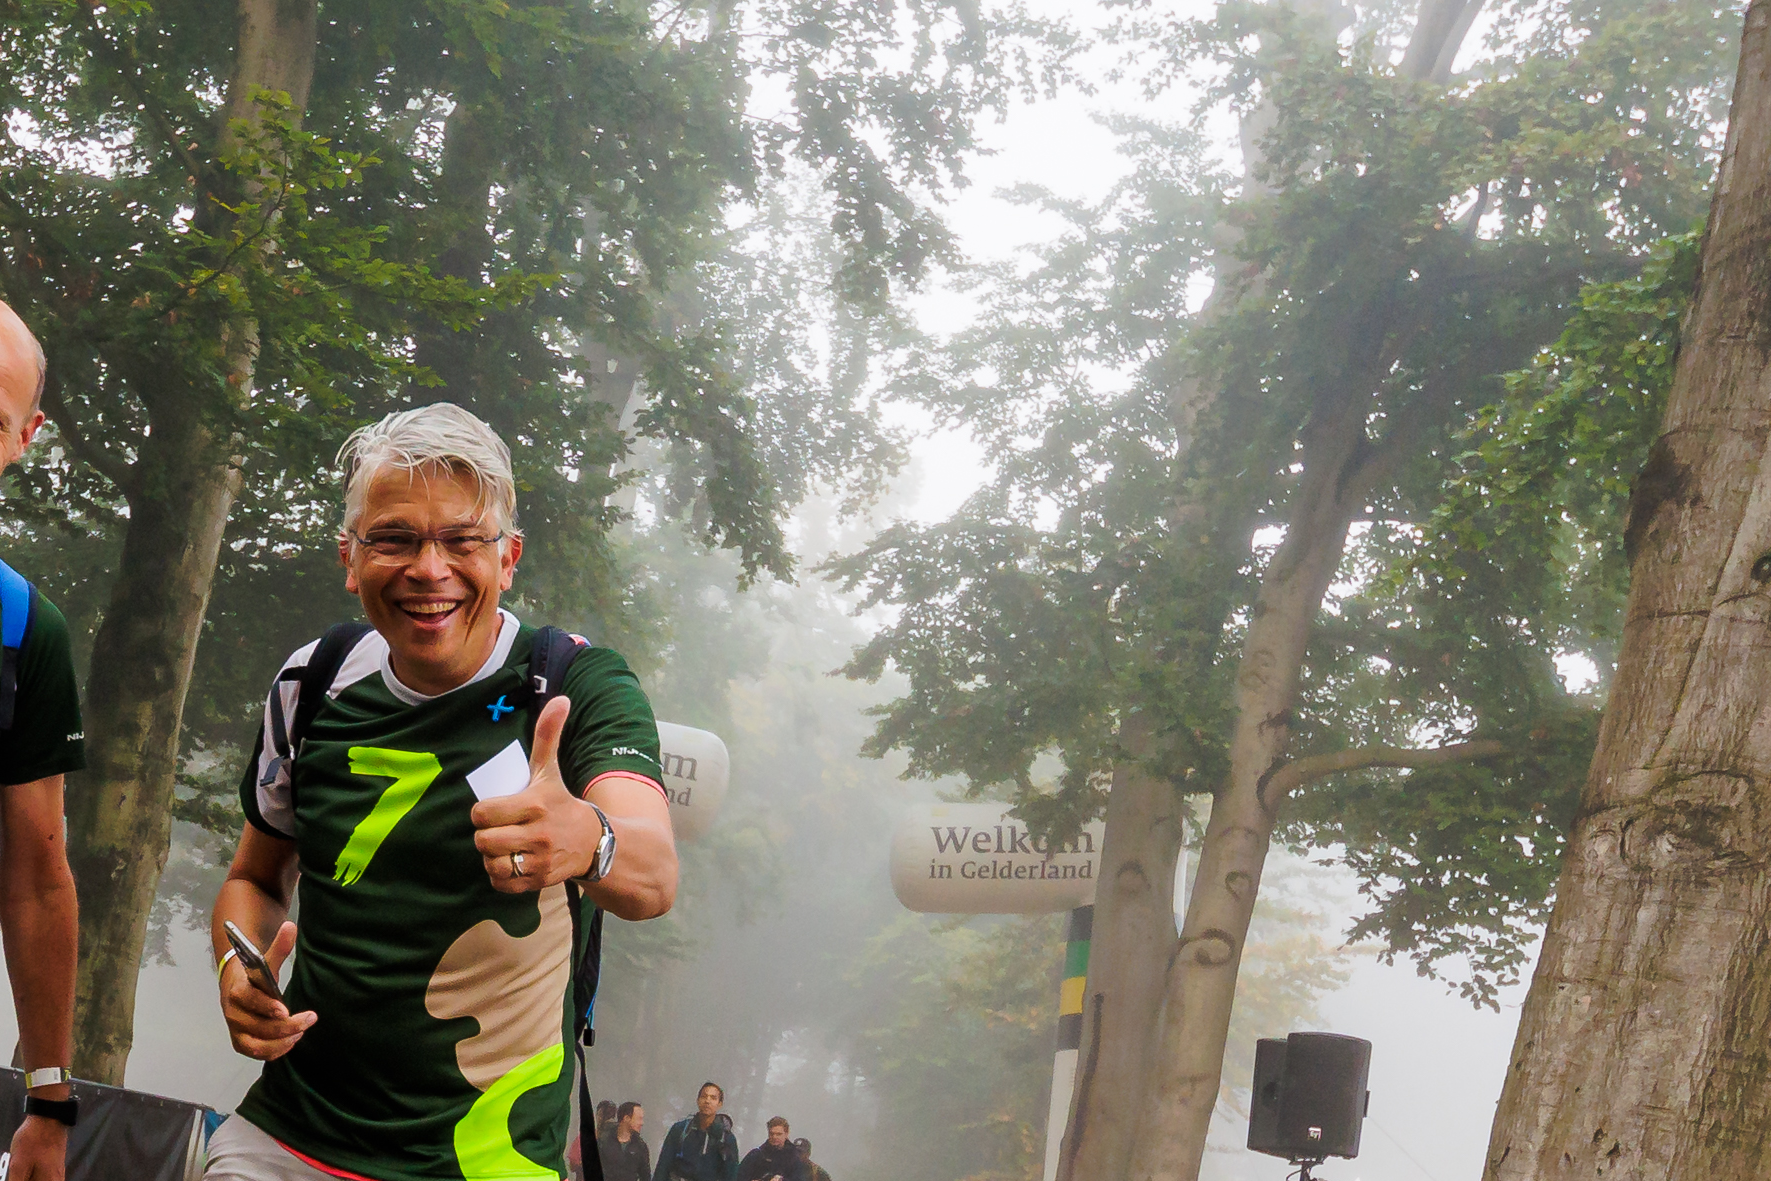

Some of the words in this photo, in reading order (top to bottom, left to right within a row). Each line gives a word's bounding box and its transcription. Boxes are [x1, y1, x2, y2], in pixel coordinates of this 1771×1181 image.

[332, 746, 443, 887] 7
[929, 858, 953, 879] in
[960, 859, 1093, 880] Gelderland
